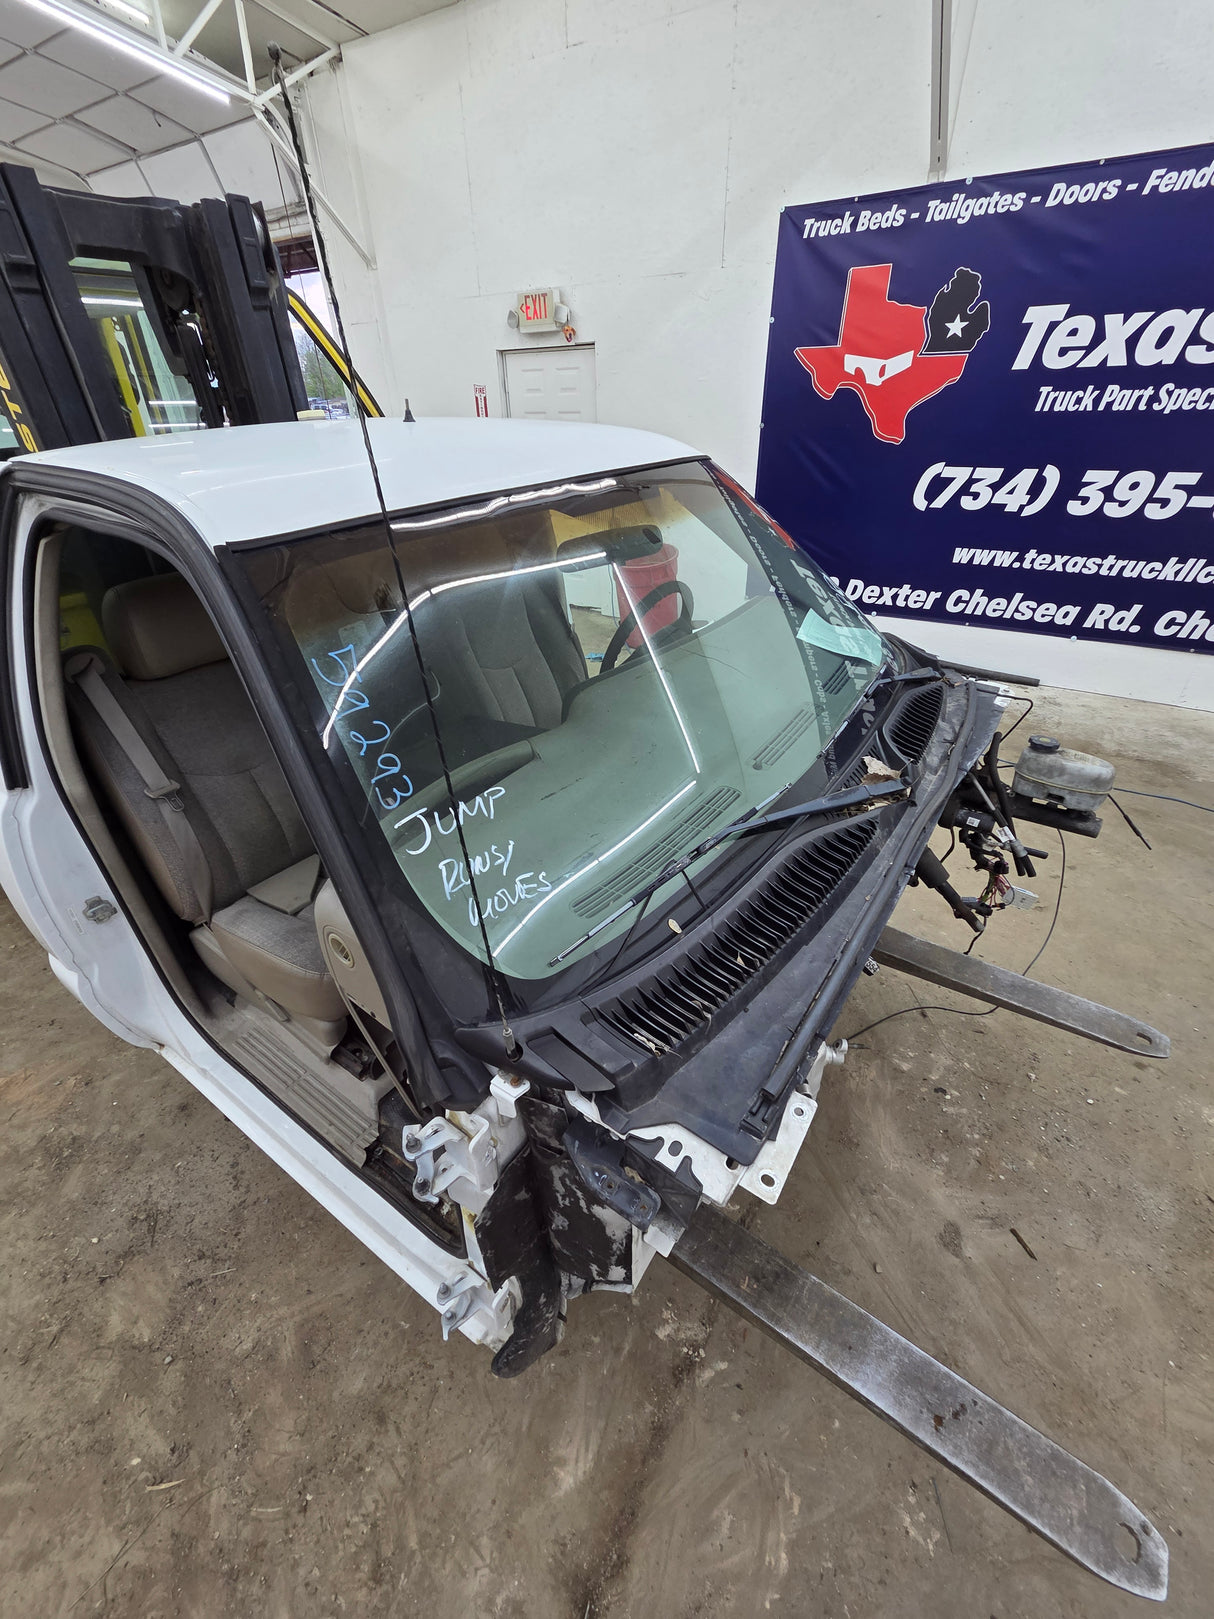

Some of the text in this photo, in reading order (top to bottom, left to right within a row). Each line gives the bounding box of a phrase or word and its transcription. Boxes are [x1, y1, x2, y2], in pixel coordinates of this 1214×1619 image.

[803, 212, 855, 239] Truck
[856, 204, 906, 232] Beds
[924, 190, 1026, 225] Tailgates
[1045, 179, 1122, 208] Doors
[1141, 159, 1214, 195] Fend
[524, 292, 548, 321] EXIT
[475, 387, 486, 395] FIRE
[1034, 383, 1214, 414] Truck Part Spec
[912, 461, 1214, 520] (734) 395-
[845, 578, 943, 611] Dexter
[945, 588, 1082, 627] Chelsea
[1082, 603, 1144, 634] Rd.
[394, 786, 506, 855] JUMP
